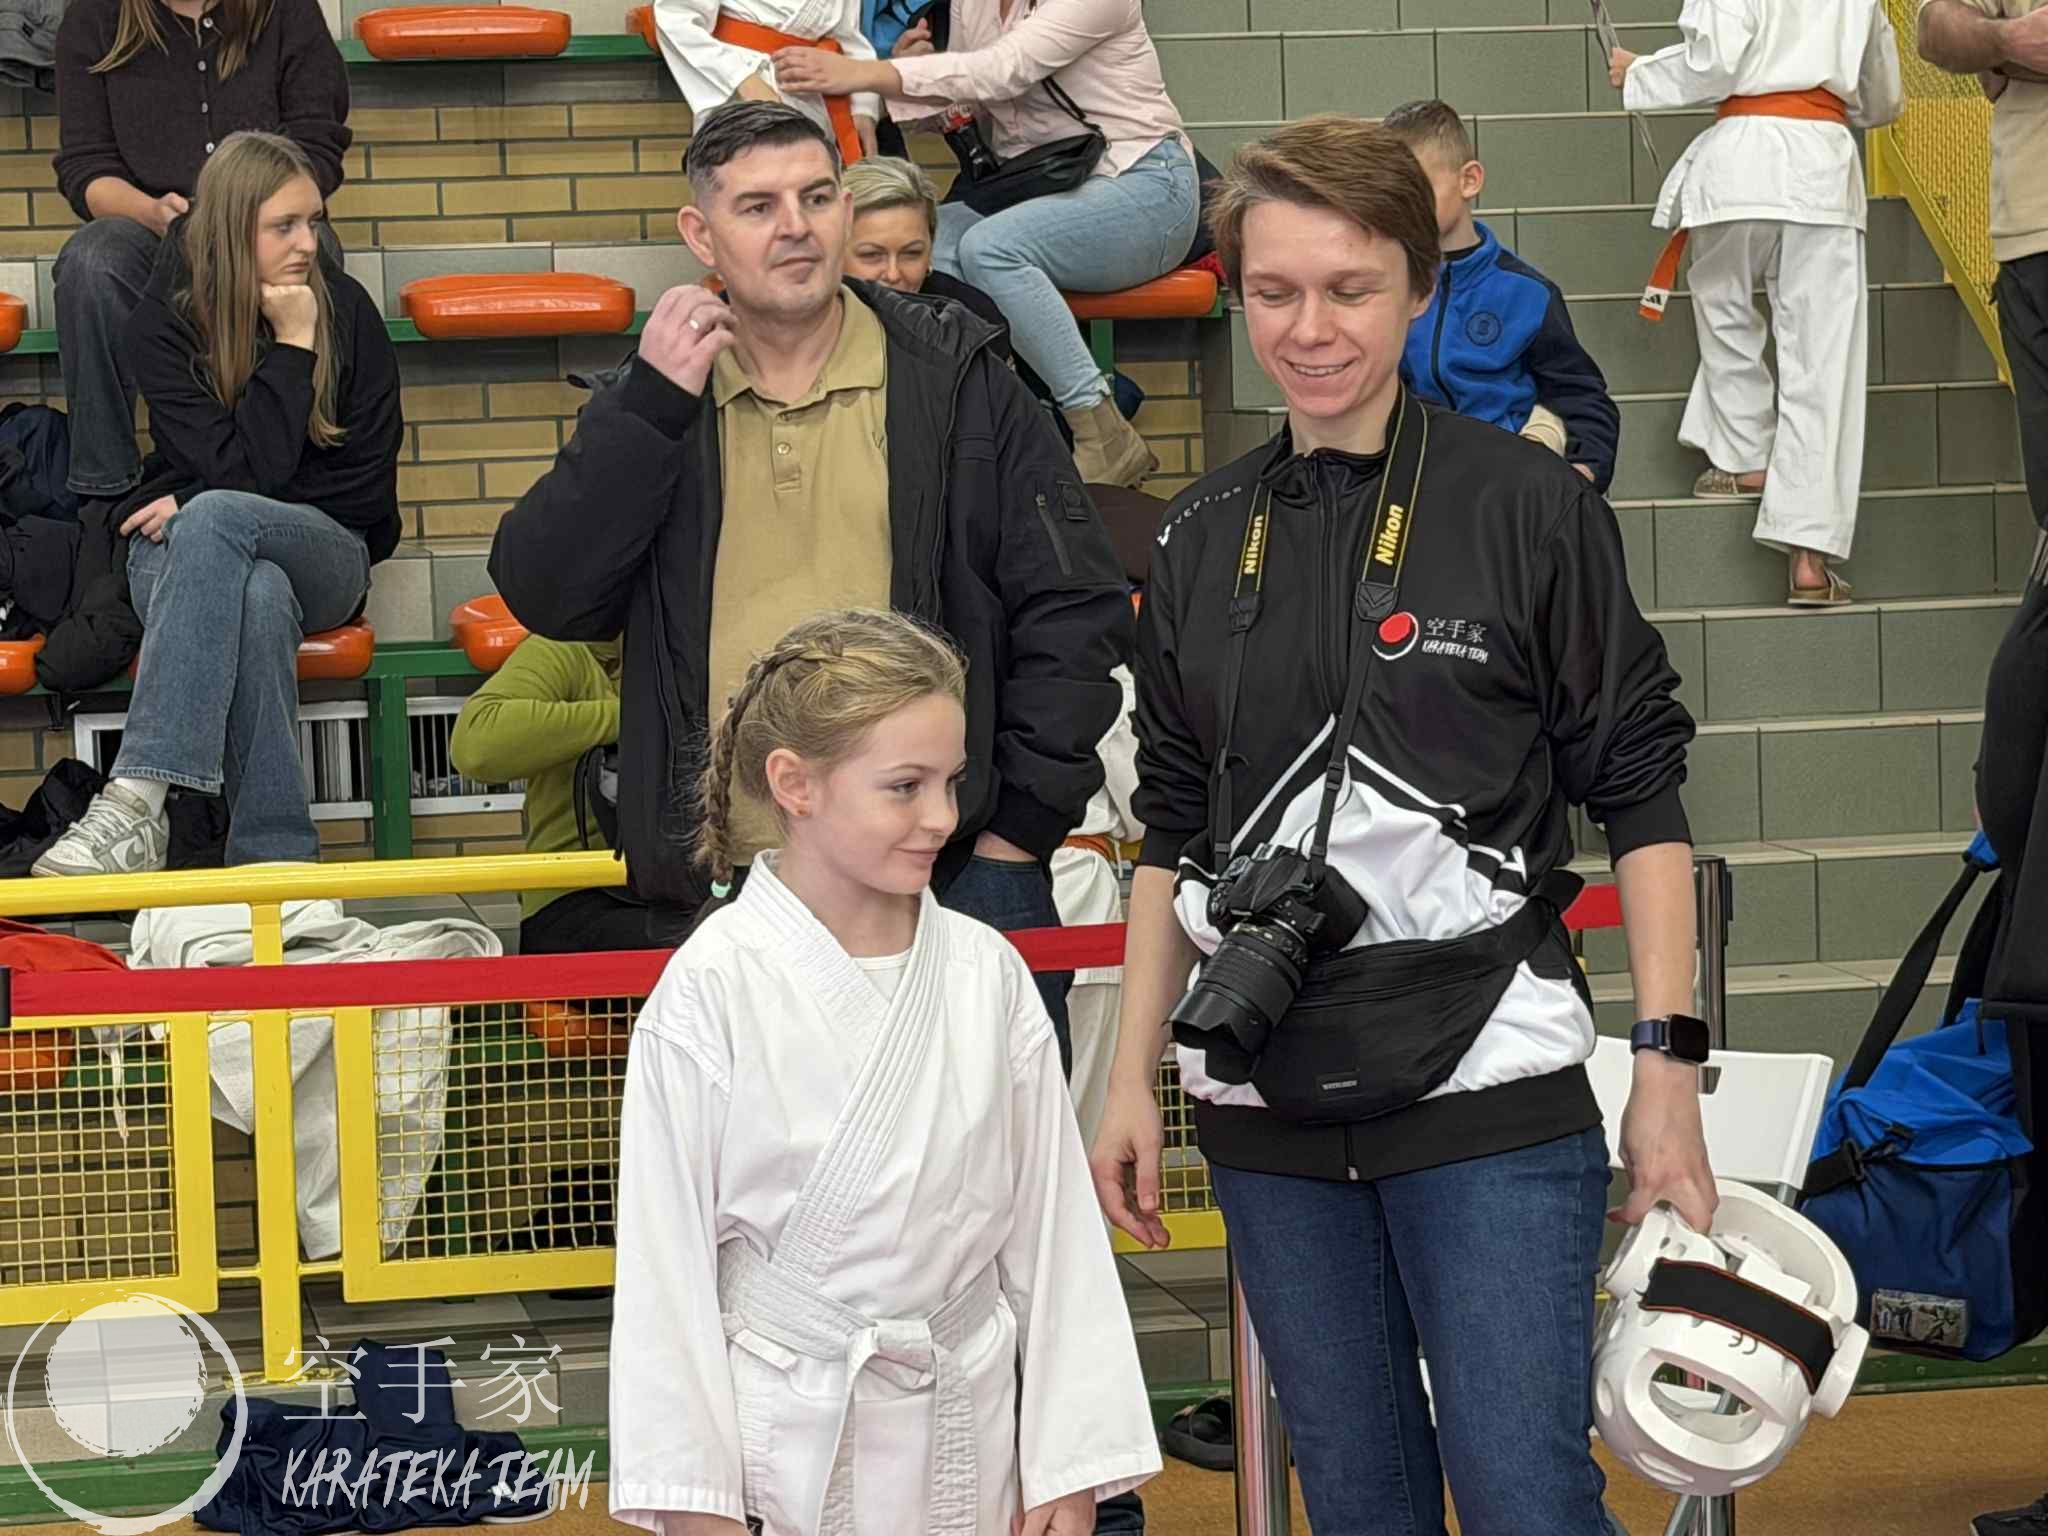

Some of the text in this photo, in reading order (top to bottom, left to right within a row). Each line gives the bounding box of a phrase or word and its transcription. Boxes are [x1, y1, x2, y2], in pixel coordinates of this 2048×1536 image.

[1243, 514, 1265, 575] Nikon
[1374, 503, 1405, 566] Nikon
[1424, 617, 1487, 643] 空手家
